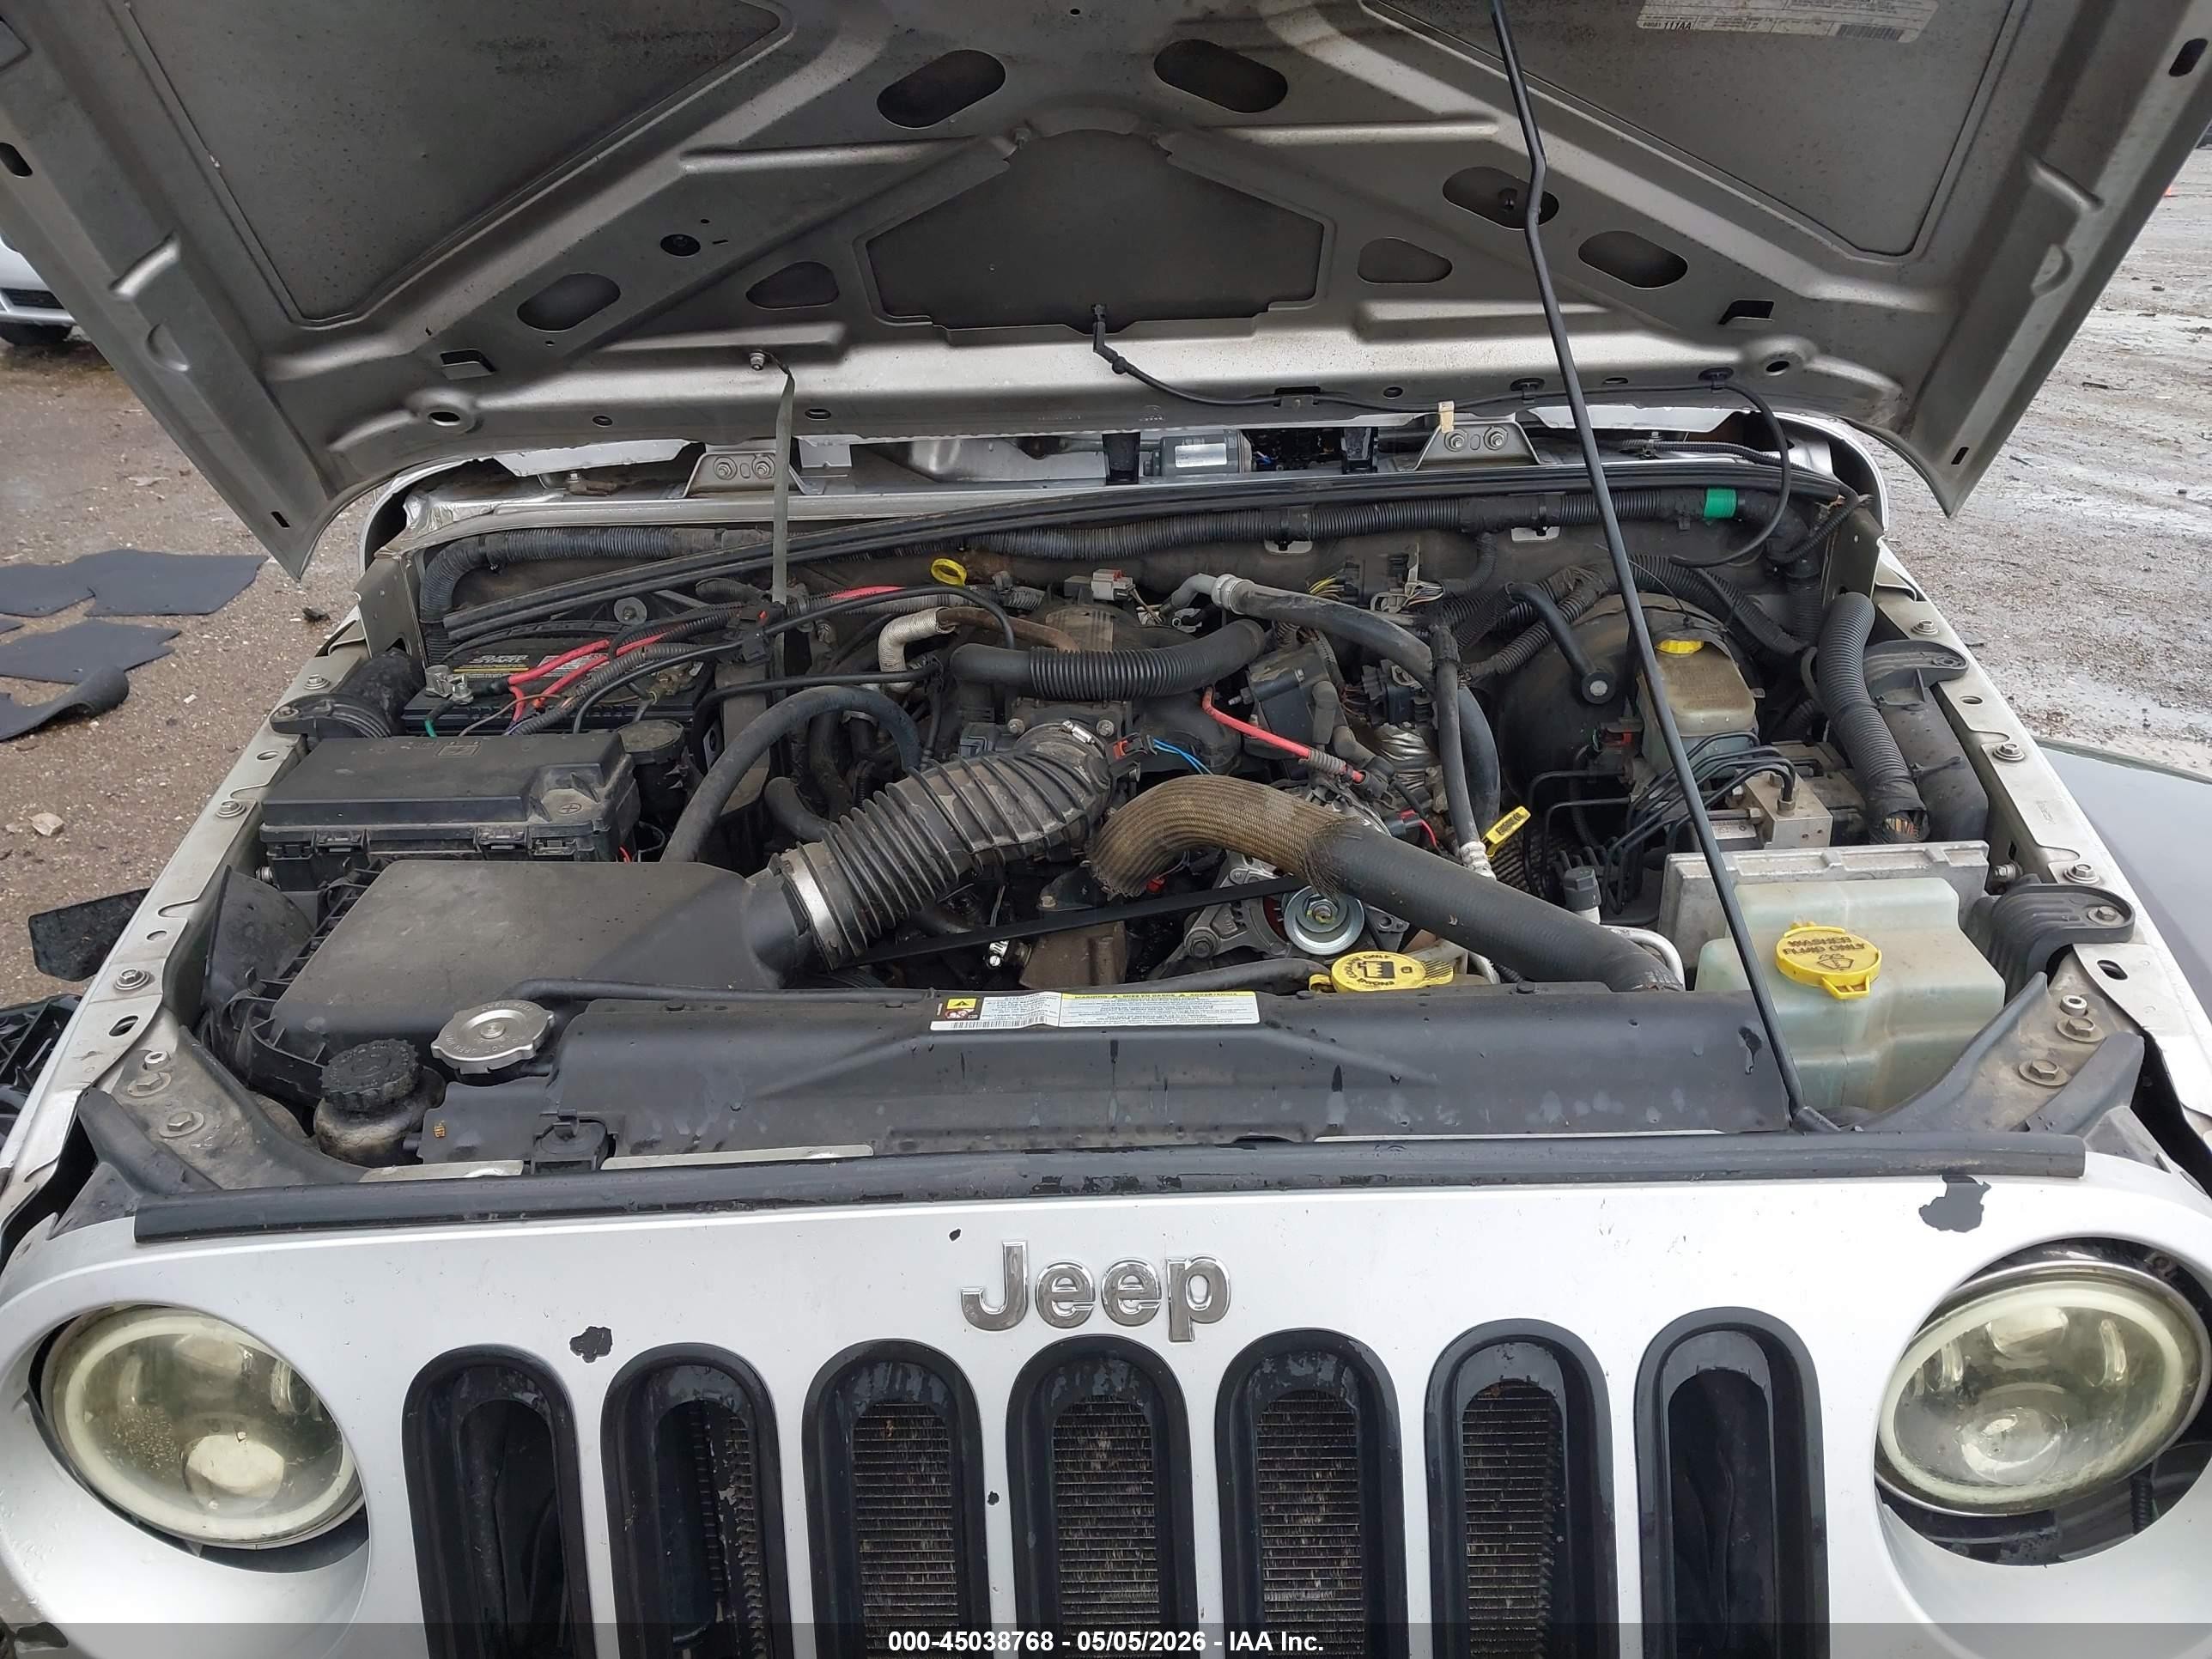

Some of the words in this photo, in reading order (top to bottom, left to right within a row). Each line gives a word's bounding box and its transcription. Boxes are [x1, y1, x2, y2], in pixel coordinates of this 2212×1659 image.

[1787, 936, 1853, 947] WASHER
[1782, 945, 1826, 956] FLUID
[1829, 943, 1866, 952] ONLY
[961, 1239, 1231, 1342] Jeep
